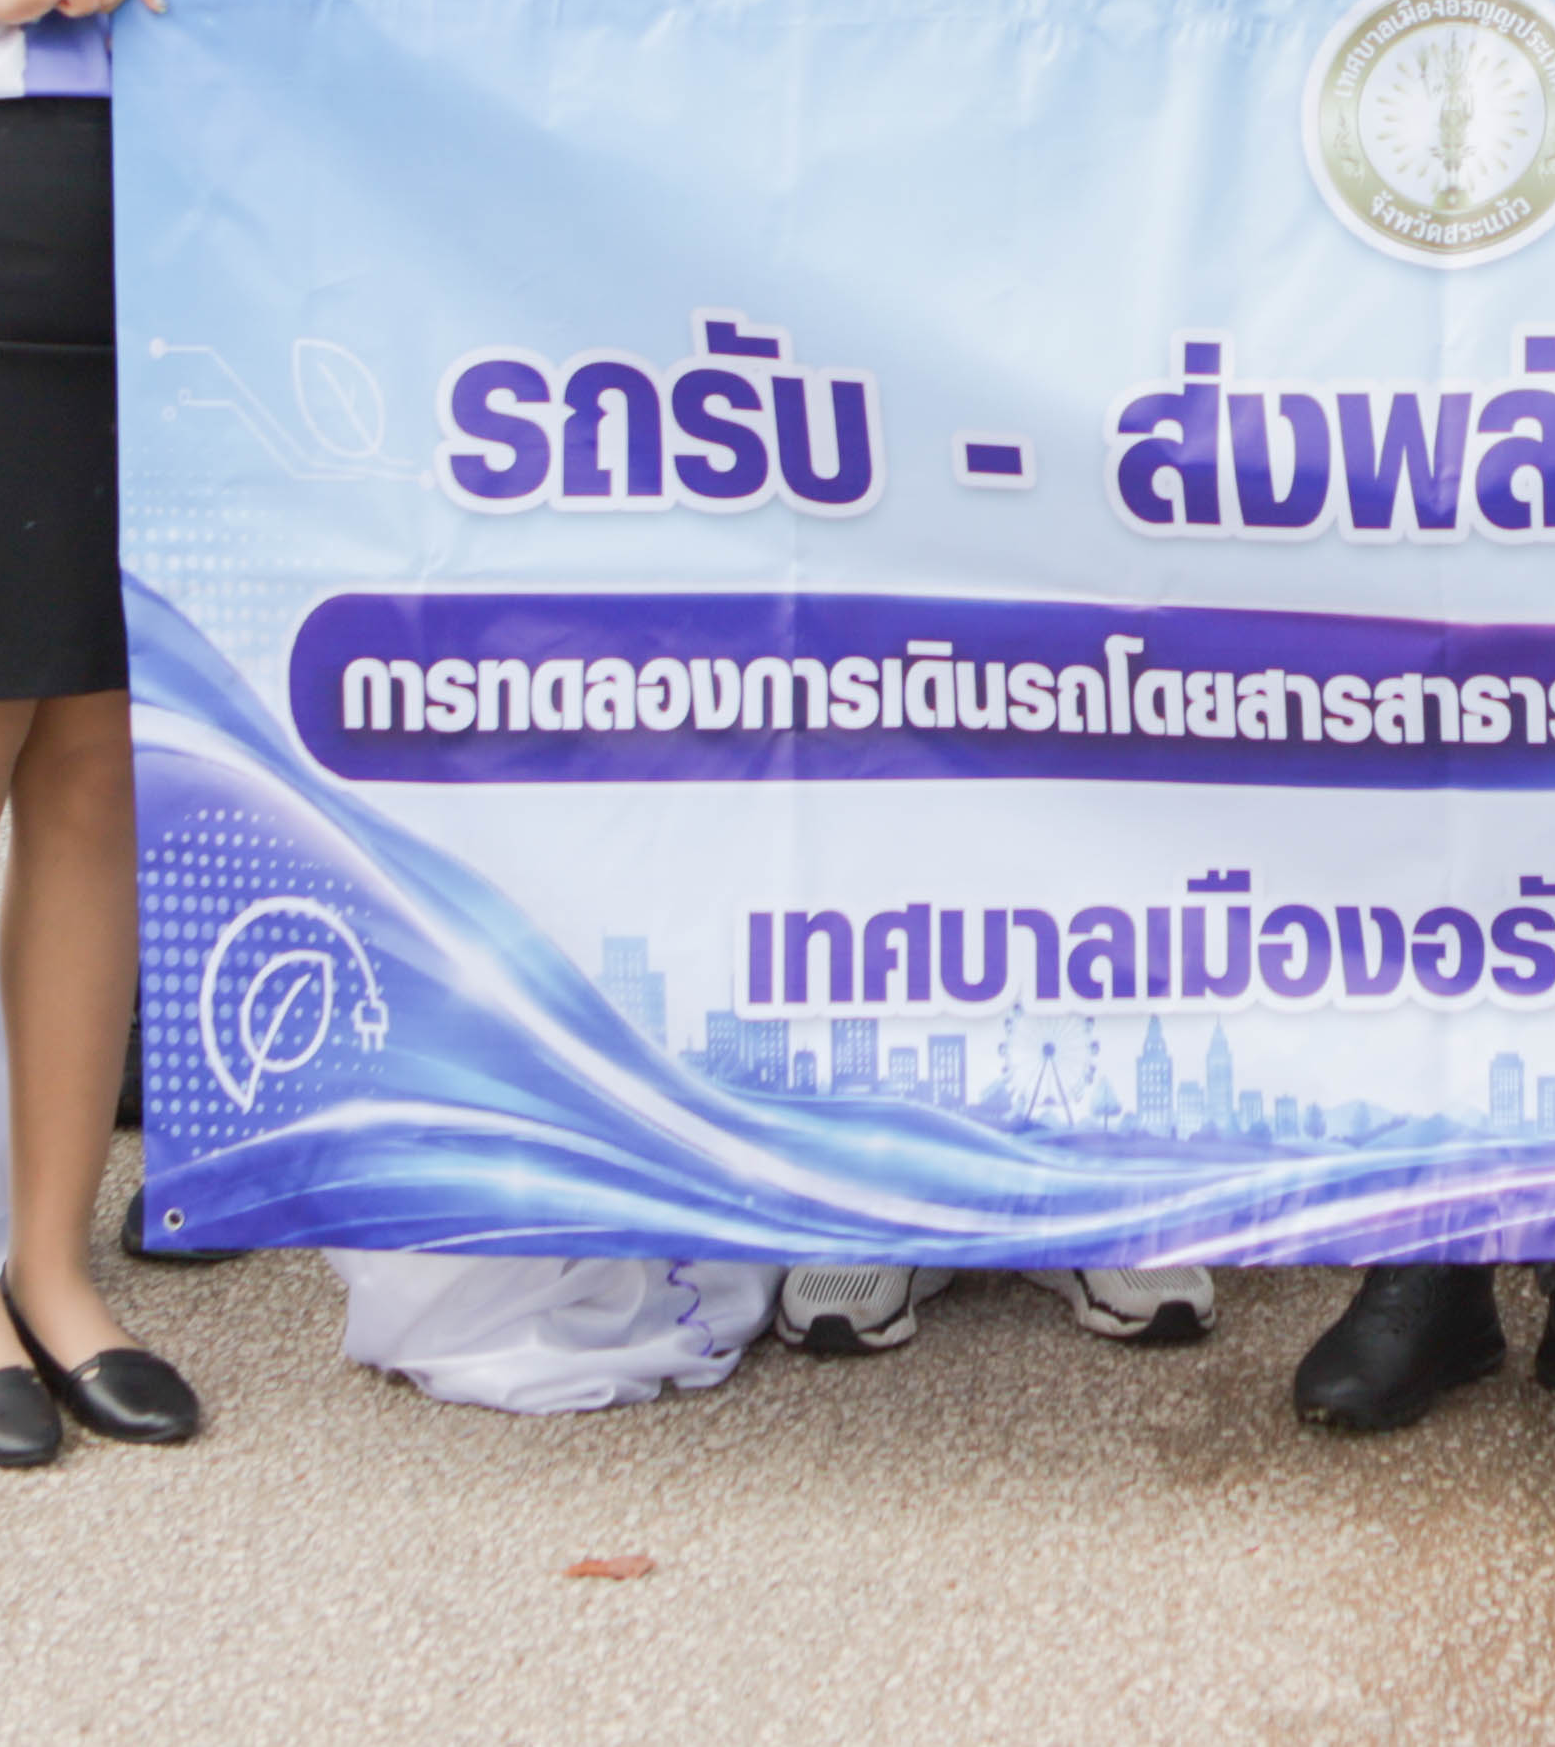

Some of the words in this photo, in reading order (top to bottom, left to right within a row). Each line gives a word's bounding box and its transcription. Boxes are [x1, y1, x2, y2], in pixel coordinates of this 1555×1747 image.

[1369, 191, 1532, 244] จังหวัดสระแก้ว
[450, 320, 872, 504] รถรับ
[966, 443, 1022, 475] -
